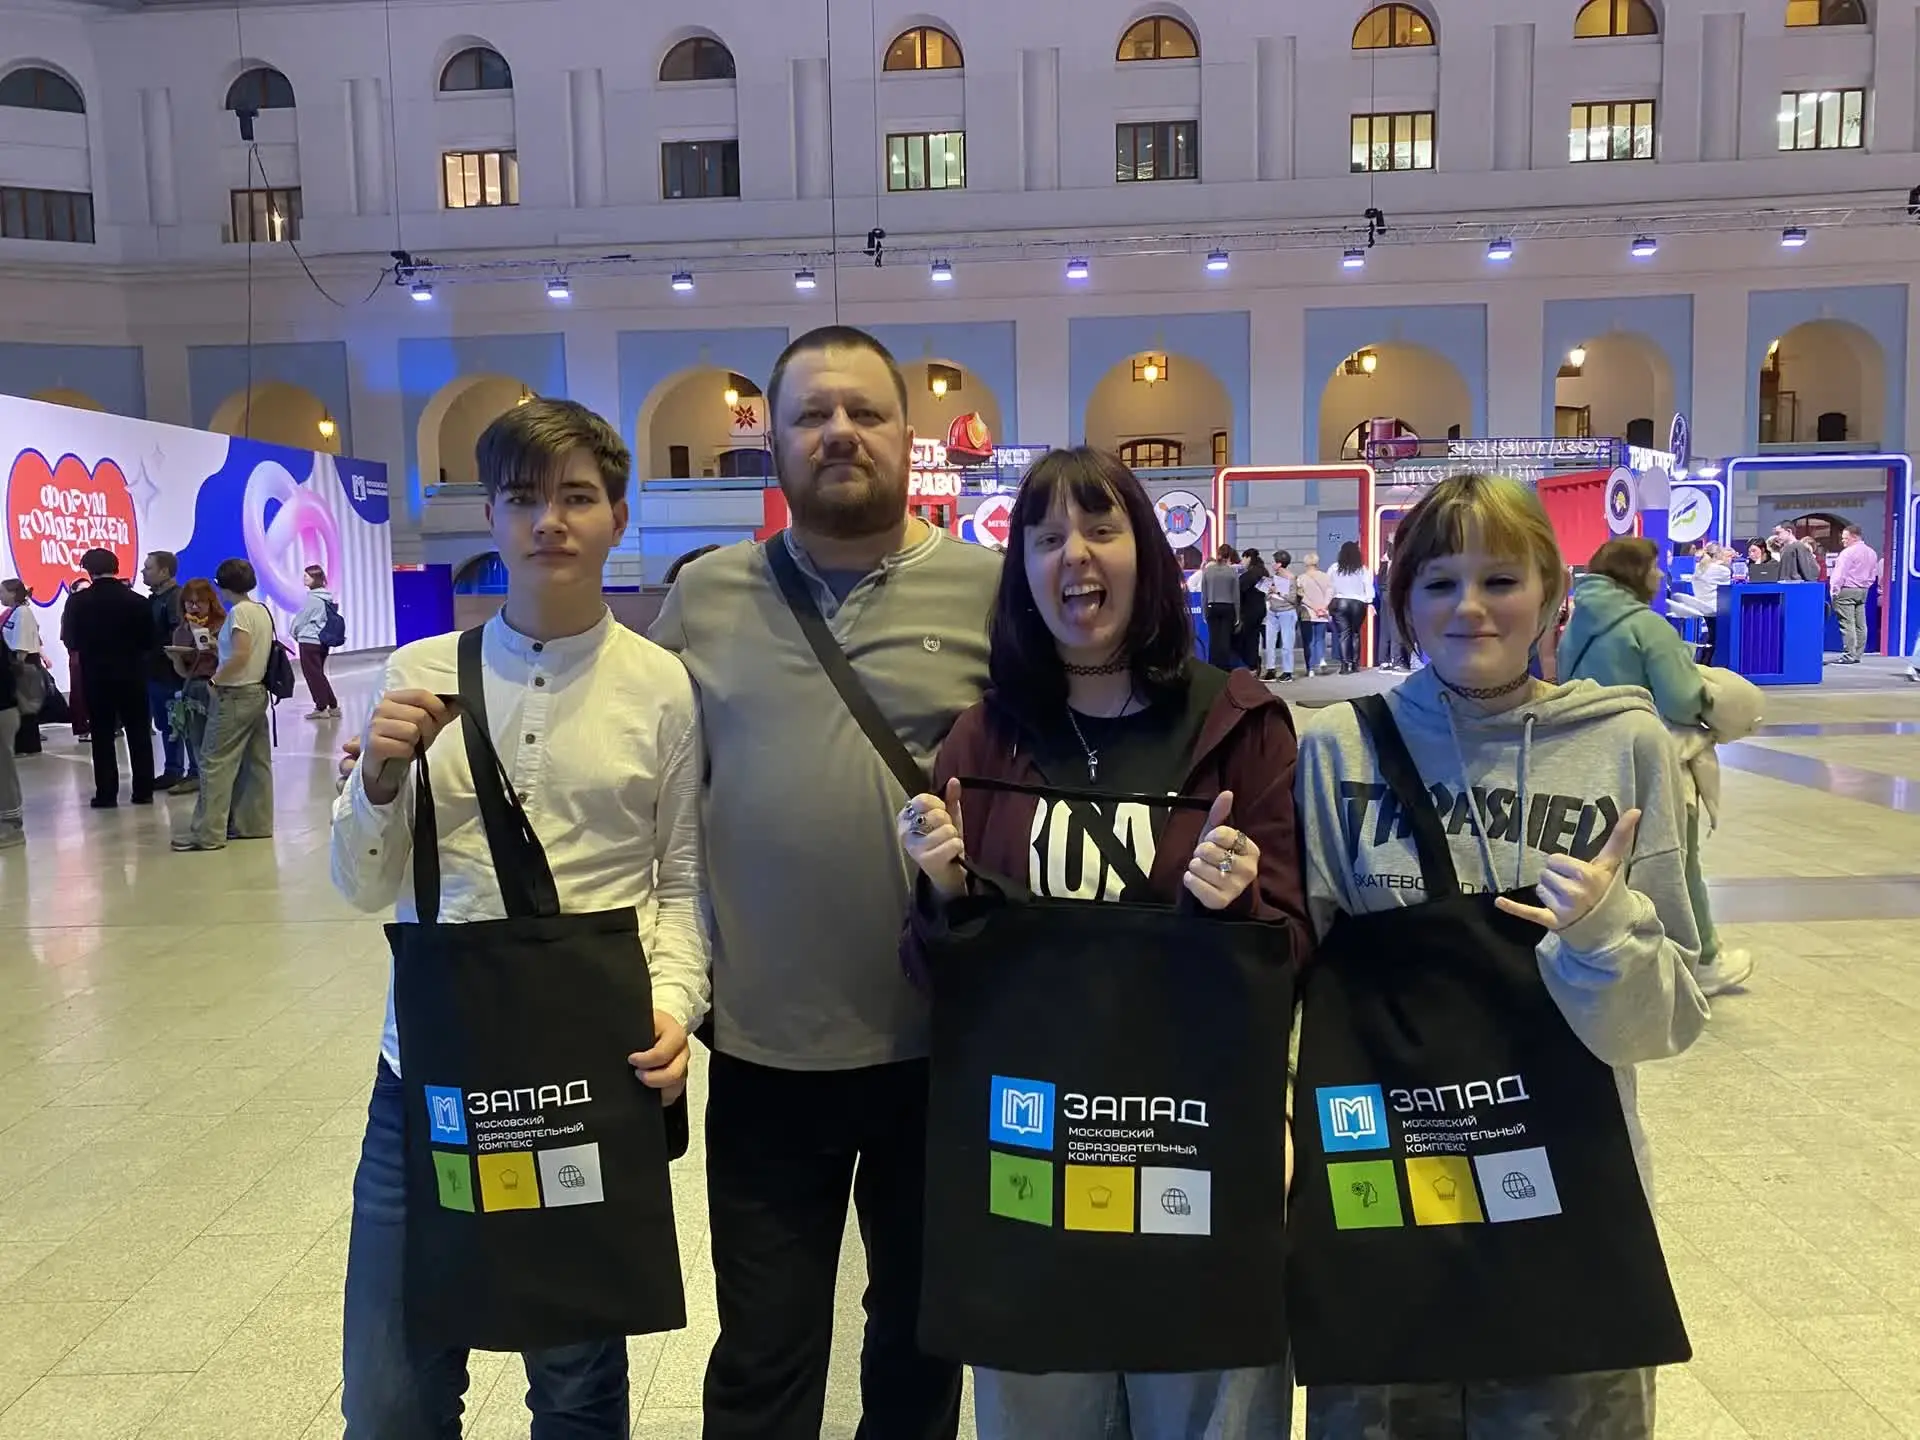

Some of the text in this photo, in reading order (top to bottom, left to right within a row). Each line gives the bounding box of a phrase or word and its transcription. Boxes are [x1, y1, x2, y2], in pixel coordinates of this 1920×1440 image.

[40, 484, 107, 517] ФОРУМ
[18, 508, 129, 546] КОЛЛЕДЖЕЙ
[41, 539, 116, 573] МОС
[467, 1079, 592, 1115] ЗАПАД
[1389, 1074, 1530, 1112] ЗАПАД
[1063, 1093, 1209, 1127] ЗАПАД
[475, 1116, 544, 1129] МОСКОВСКИЙ
[477, 1122, 584, 1141] ОБРАЗОВАТЕЛЬНЫЙ
[1402, 1115, 1477, 1129] МОСКОВСКИЙ
[1068, 1127, 1154, 1138] МОСКОВСКИЙ
[1404, 1123, 1525, 1143] ОБРАЗОВАТЕЛЬНЫЙ
[478, 1140, 533, 1150] КОМПЛЕКС
[1068, 1141, 1197, 1155] ОБРАЗОВАТЕЛЬНЫЙ
[1406, 1143, 1467, 1153] КОМПЛЕКС
[1068, 1152, 1136, 1162] КОМПЛЕКС
